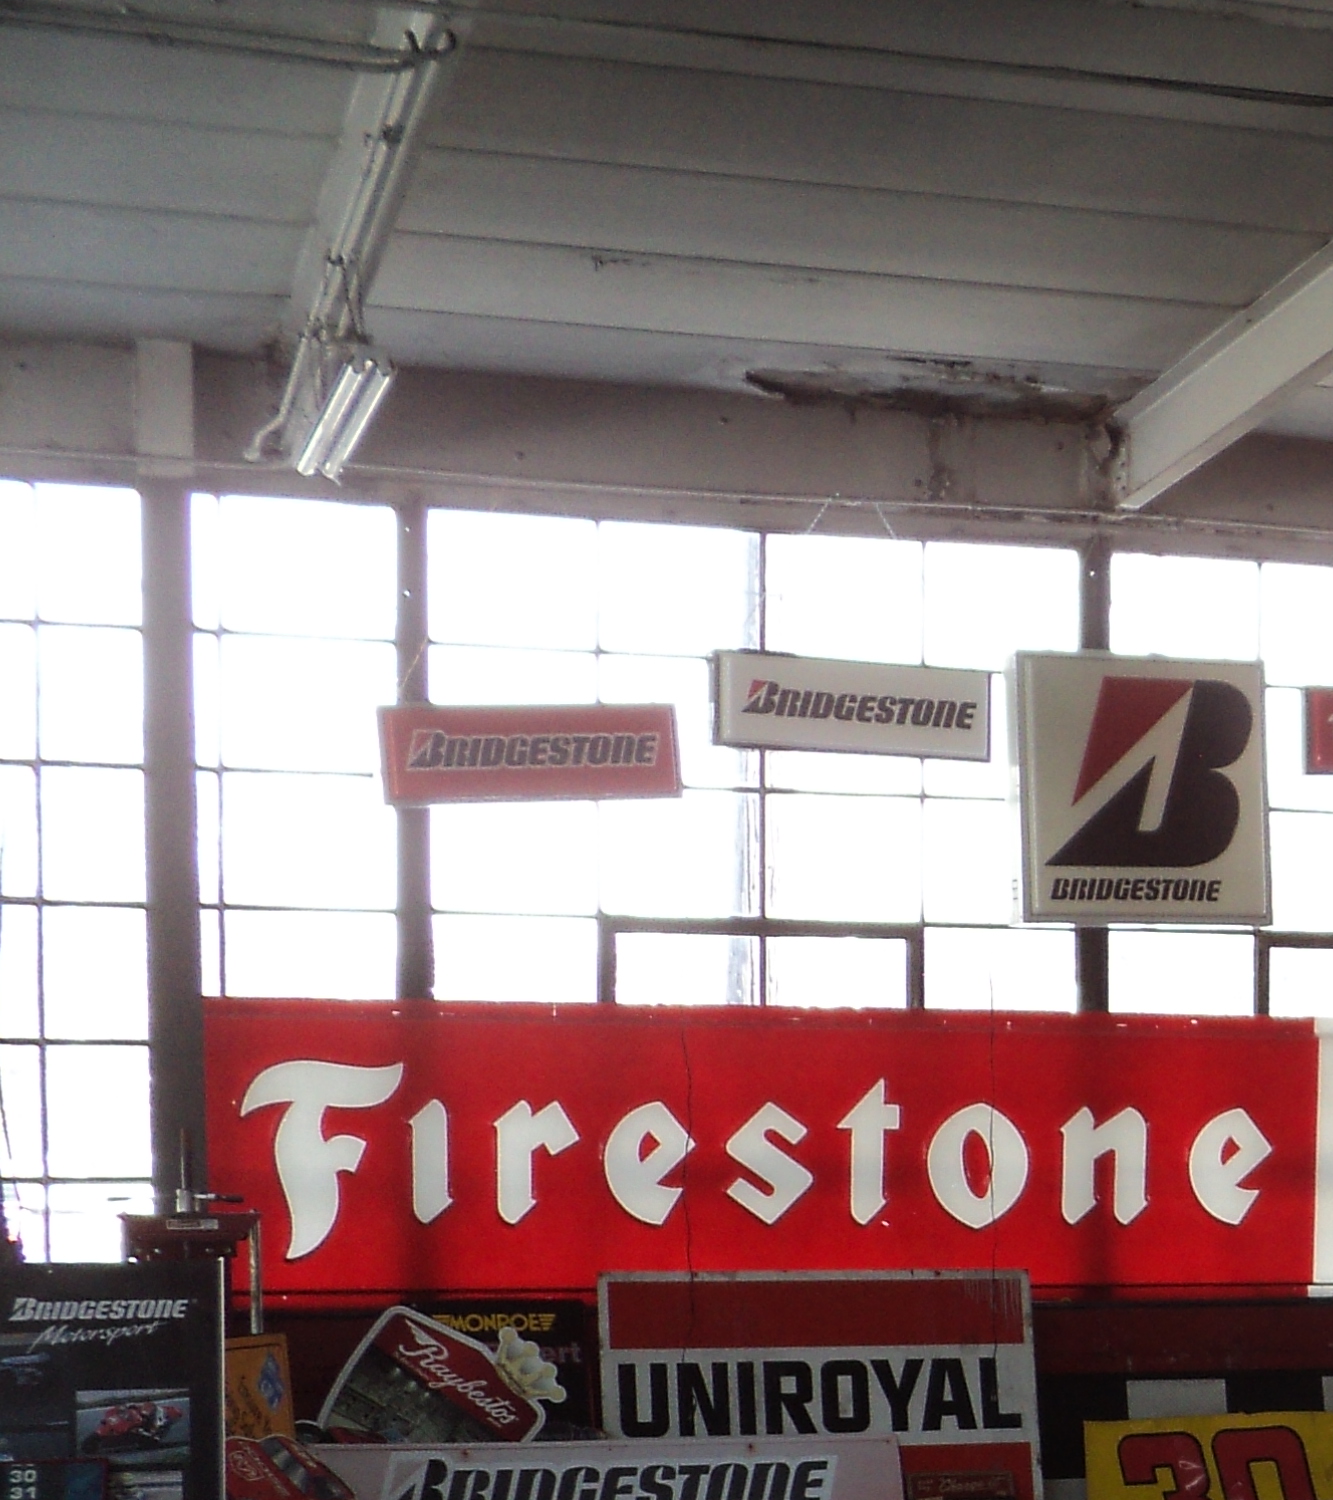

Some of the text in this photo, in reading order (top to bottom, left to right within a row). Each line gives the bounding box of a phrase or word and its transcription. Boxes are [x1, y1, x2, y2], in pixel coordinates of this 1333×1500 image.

[742, 679, 978, 730] BRIDGESTONE
[406, 729, 659, 771] BRIDGESTONE
[1050, 878, 1222, 903] BRIDGESTONE
[241, 1060, 1272, 1260] Firestone
[8, 1297, 189, 1321] BRIDGESTONE
[28, 1321, 169, 1353] Motorsport
[399, 1338, 519, 1425] Raybestos
[618, 1358, 1022, 1438] UNIROYAL
[9, 1469, 37, 1483] 30
[9, 1487, 36, 1499] 31
